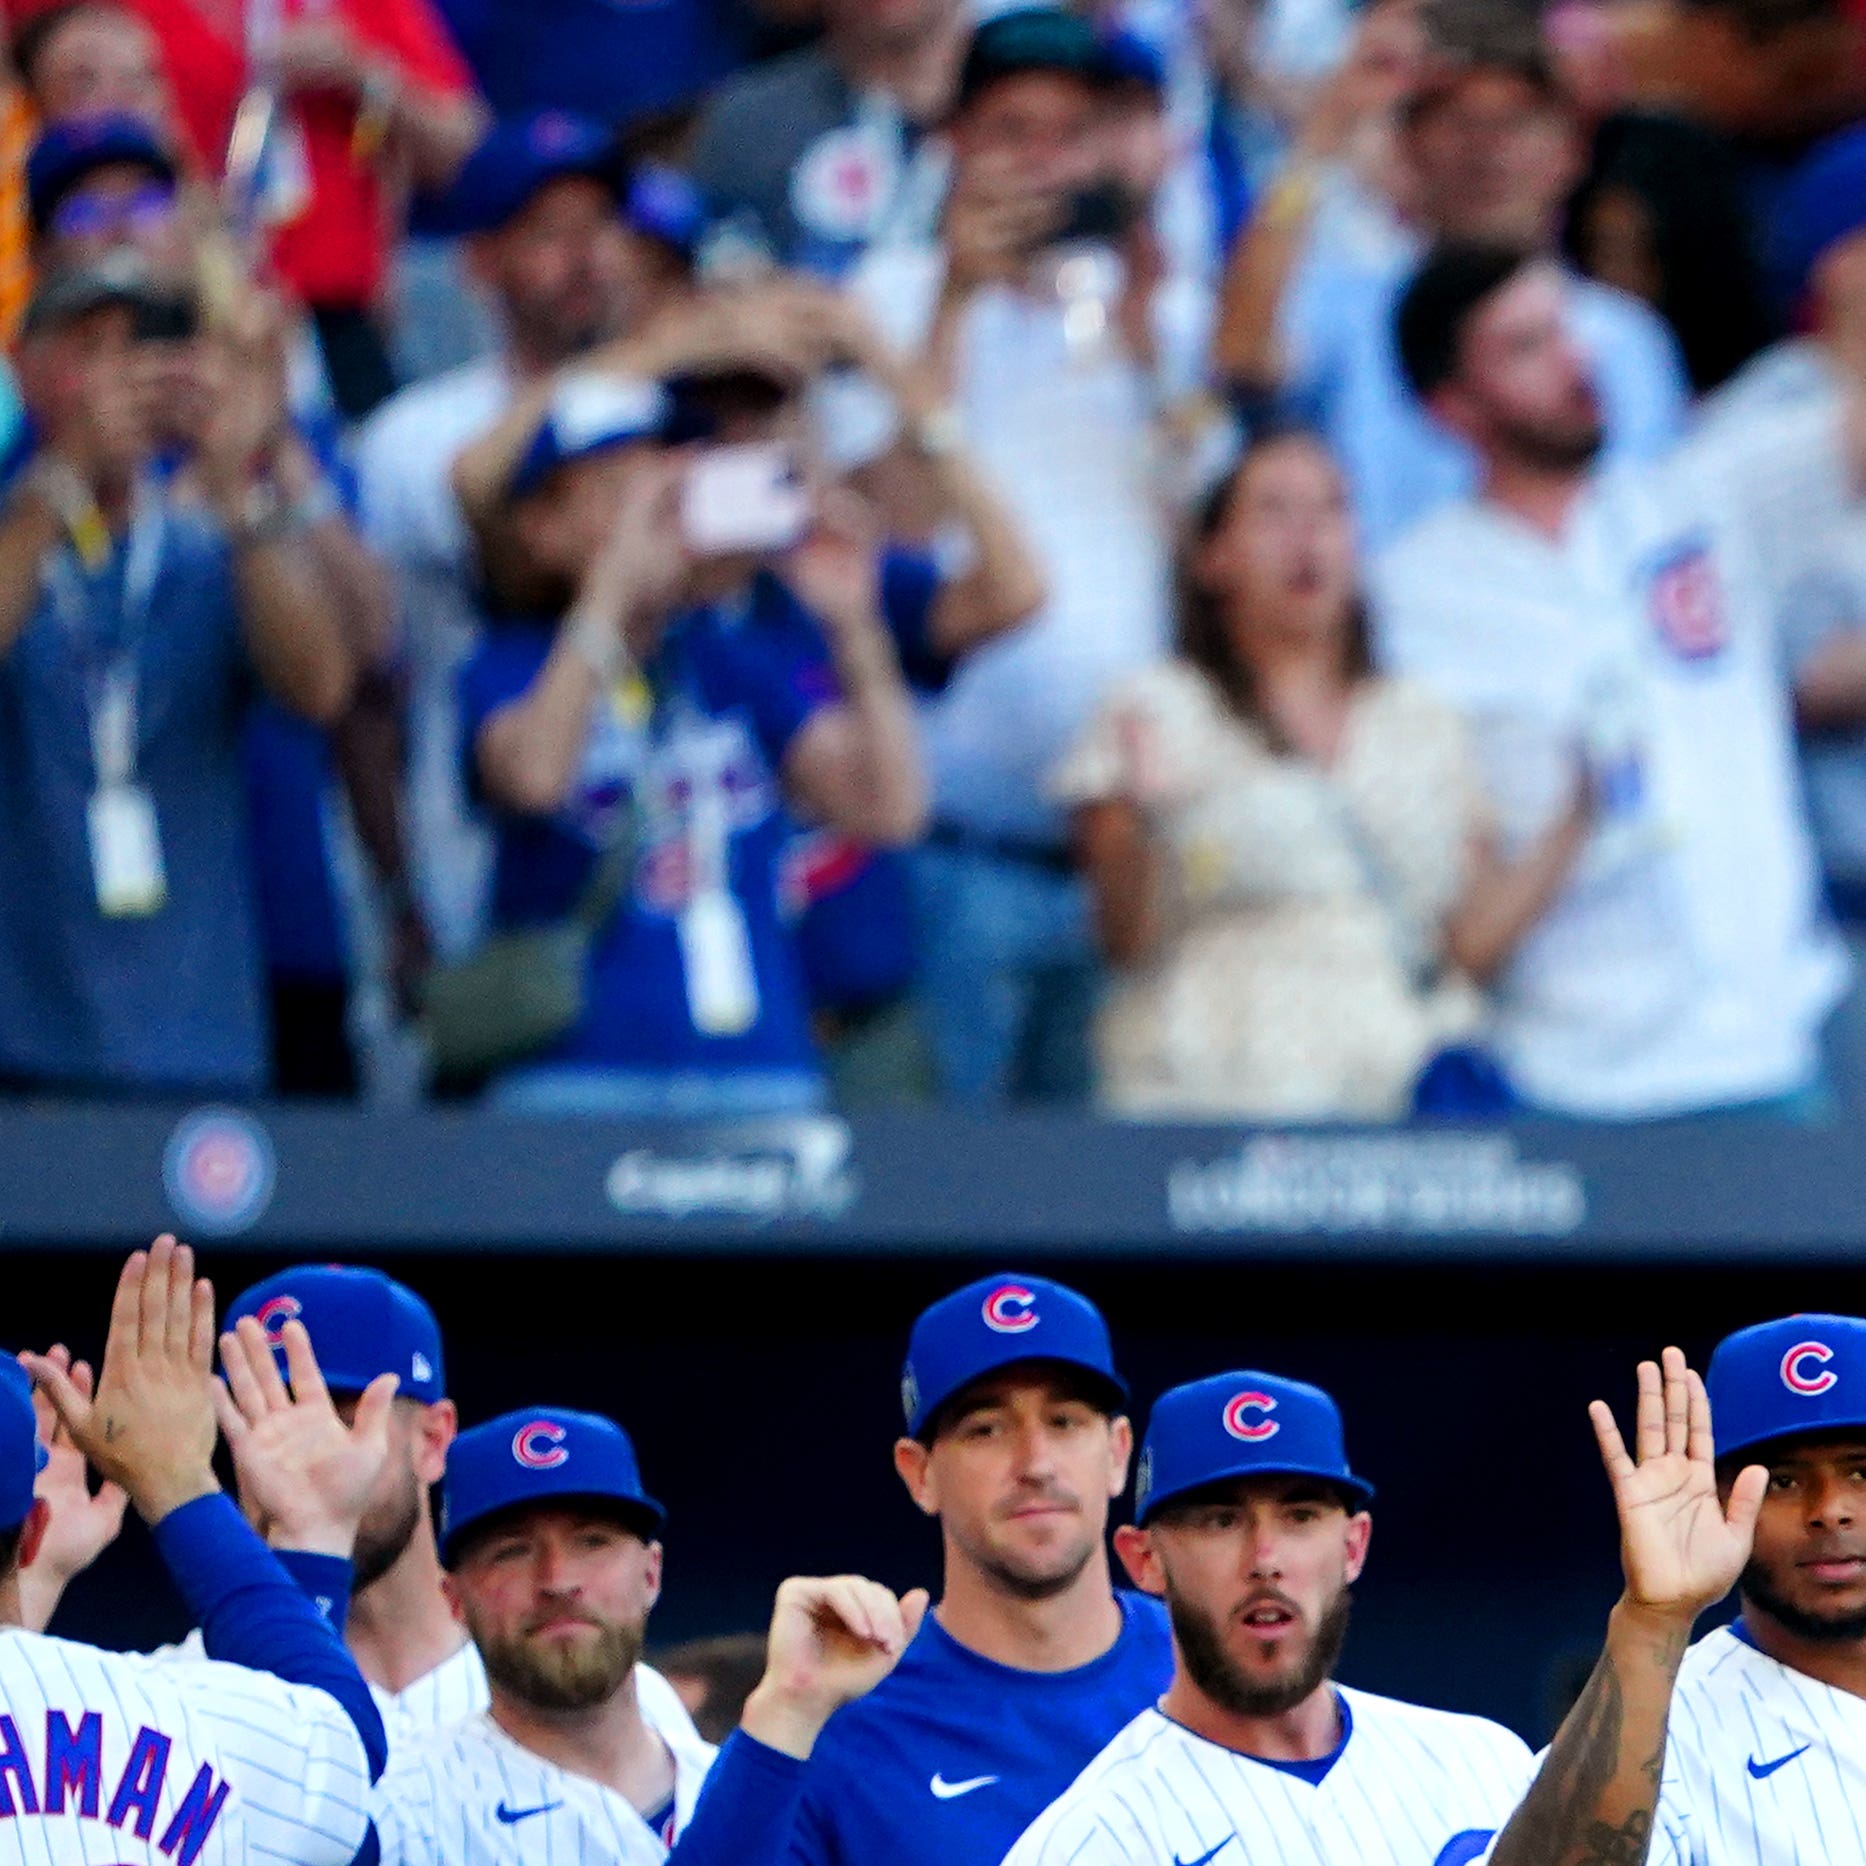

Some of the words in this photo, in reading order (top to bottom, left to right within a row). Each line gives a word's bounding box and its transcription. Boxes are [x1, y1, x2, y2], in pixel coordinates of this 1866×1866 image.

[981, 1284, 1041, 1334] C
[1778, 1340, 1839, 1397] C
[1222, 1390, 1281, 1443] C
[511, 1420, 570, 1470] C
